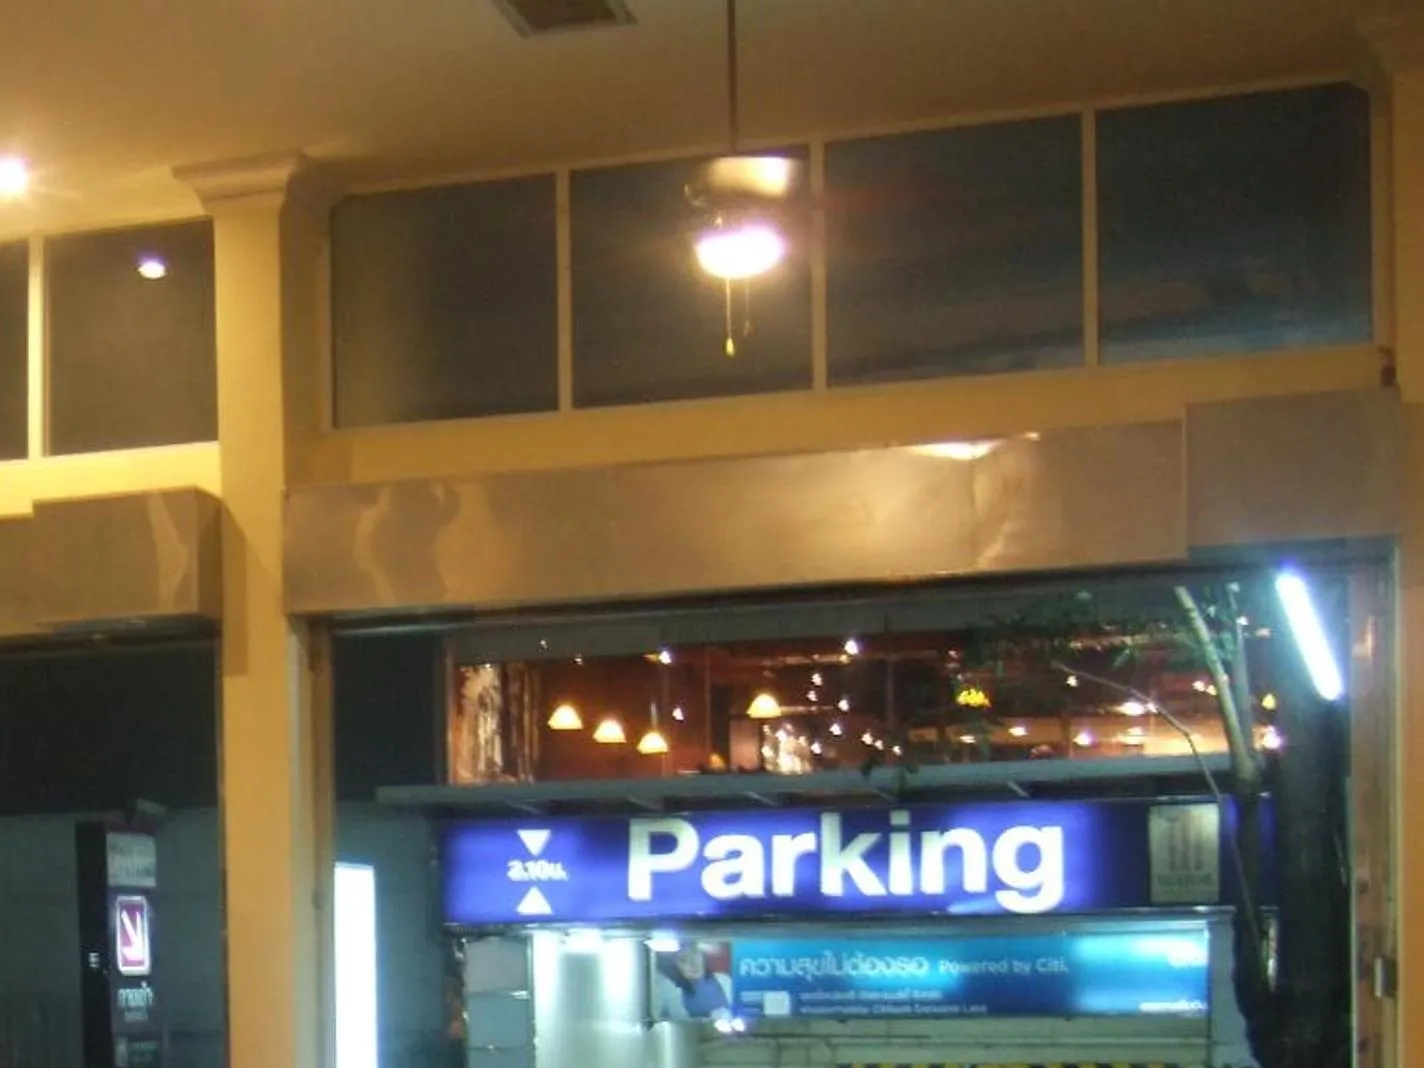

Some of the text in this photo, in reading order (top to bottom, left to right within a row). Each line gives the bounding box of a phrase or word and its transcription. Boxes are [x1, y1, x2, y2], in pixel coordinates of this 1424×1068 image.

[627, 810, 1064, 913] Parking
[938, 956, 1009, 974] Powered
[1012, 957, 1033, 976] by
